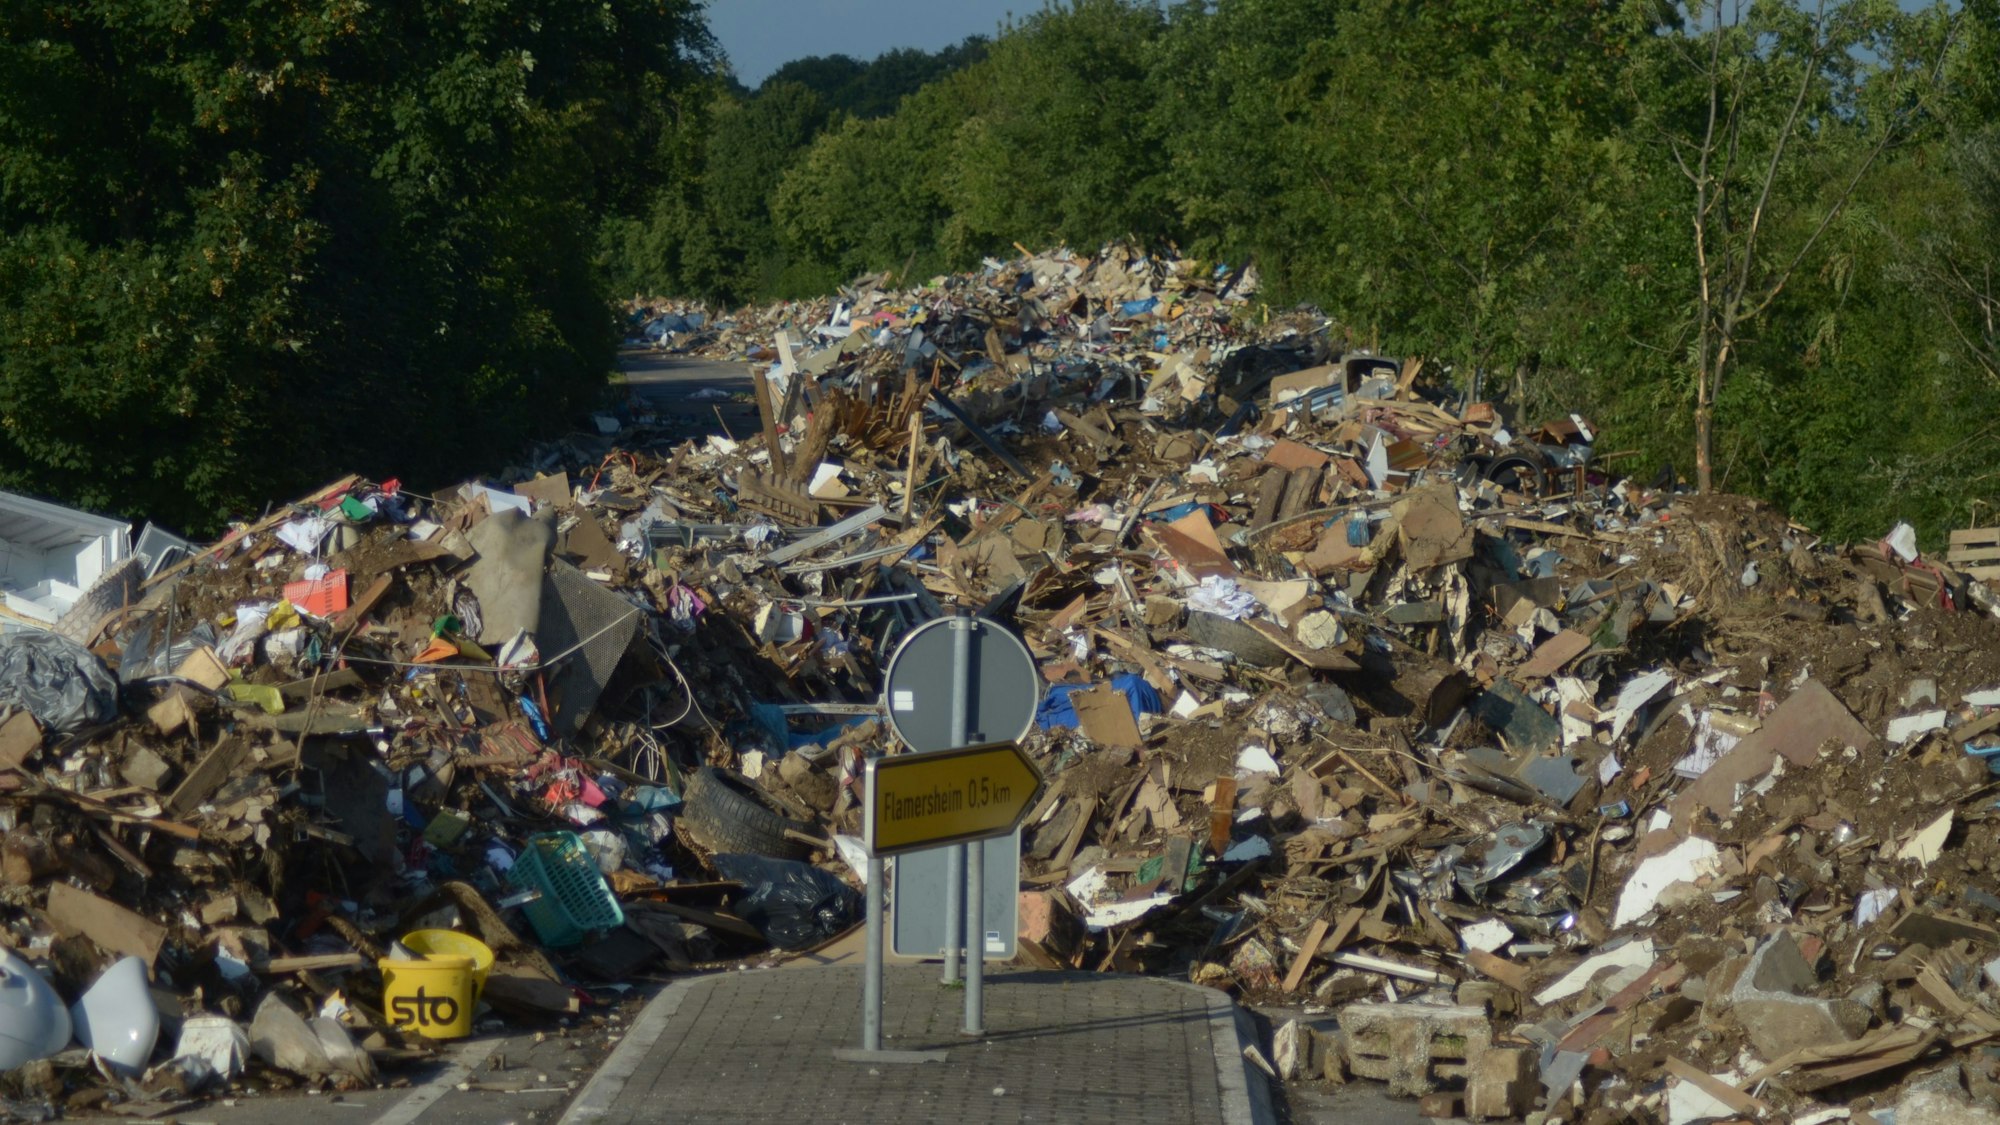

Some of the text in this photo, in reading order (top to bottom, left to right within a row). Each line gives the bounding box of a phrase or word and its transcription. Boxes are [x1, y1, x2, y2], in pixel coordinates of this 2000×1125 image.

[884, 782, 962, 823] Flamersheim
[993, 783, 1010, 804] km
[392, 985, 459, 1026] sto
